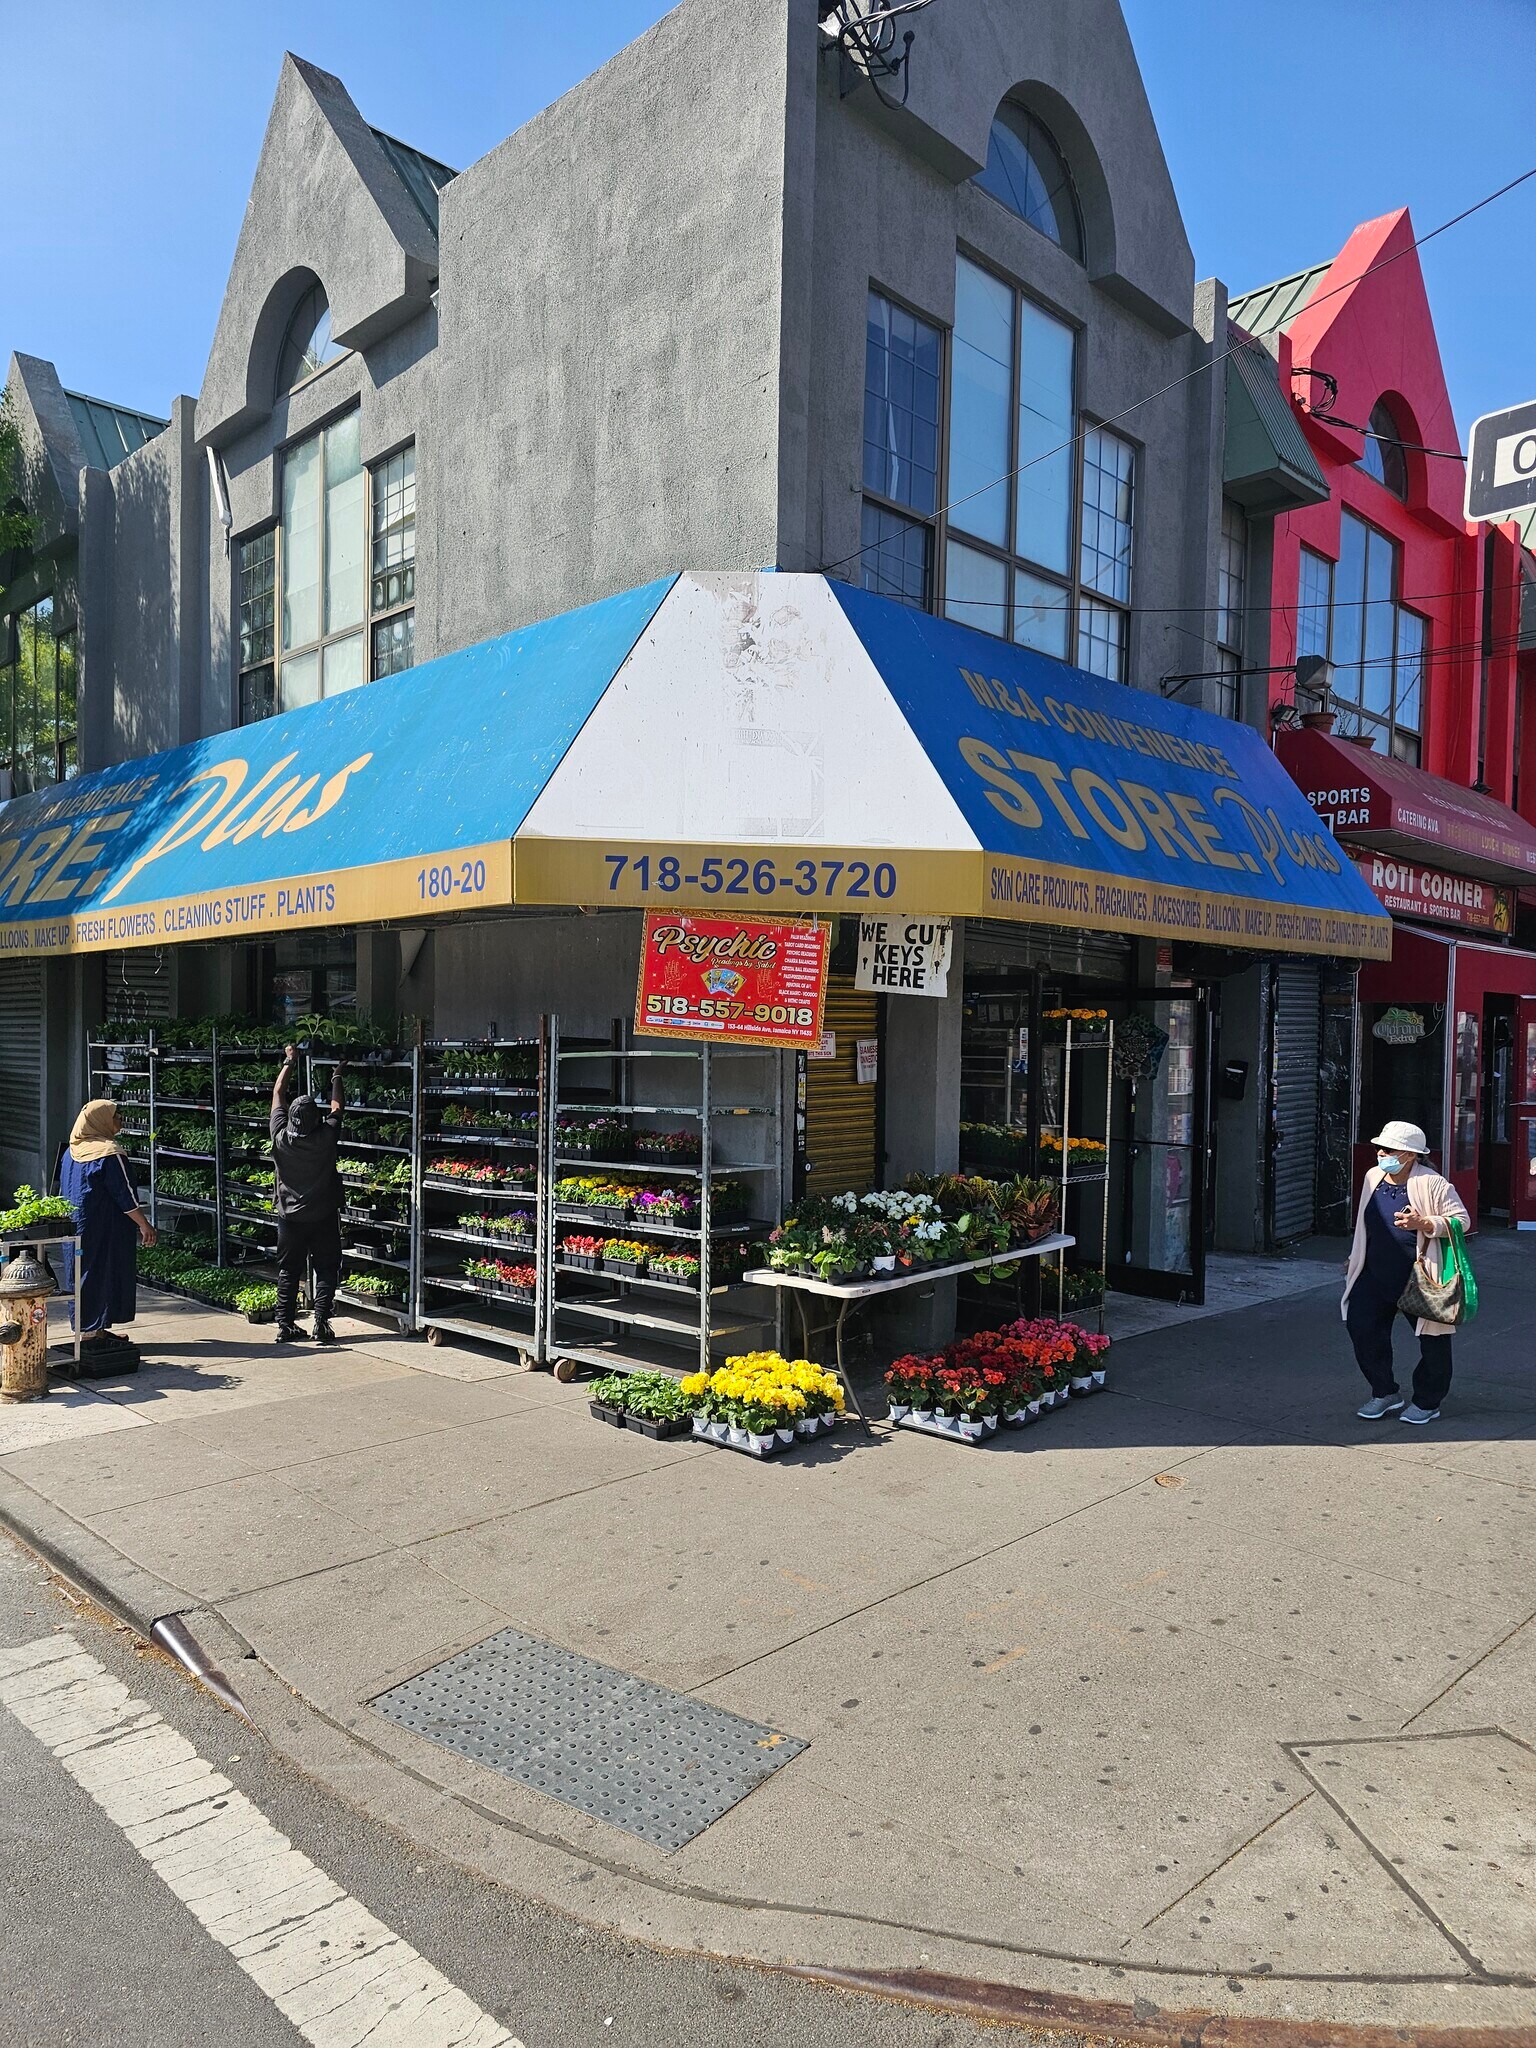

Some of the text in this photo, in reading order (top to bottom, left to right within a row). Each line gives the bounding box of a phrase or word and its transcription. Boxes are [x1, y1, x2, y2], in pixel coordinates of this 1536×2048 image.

[958, 667, 1242, 782] M&A CONVENIENCE
[1307, 787, 1371, 807] SPORTS
[101, 751, 373, 904] Plus
[1337, 808, 1370, 825] BAR
[1397, 808, 1427, 830] CATERING
[1214, 787, 1342, 887] Plus
[418, 860, 486, 899] 180-20
[605, 855, 897, 899] 718-526-3720
[1372, 859, 1483, 909] ROTI CORNER
[0, 883, 335, 949] LLOONS MAKE UP FRESH FLOWERS CLEANING STUFF PLANTS
[990, 866, 1389, 949] SKIN CARE PRODUCTS FRAGRANCES ACCESSORIES BALLOONS MAKE UP FRESH FLOWERS CLEANING STUFF PLANTS
[1384, 895, 1461, 921] RESTAURANT & SPORTS BAR
[652, 925, 777, 963] Psychic
[861, 921, 949, 945] WE CUT
[711, 957, 743, 967] Readings
[743, 959, 753, 969] by
[874, 944, 924, 966] KEYS
[872, 965, 926, 989] HERE
[646, 994, 814, 1026] 518-557-9018
[1374, 1023, 1424, 1037] Corona
[1389, 1034, 1415, 1042] Extra
